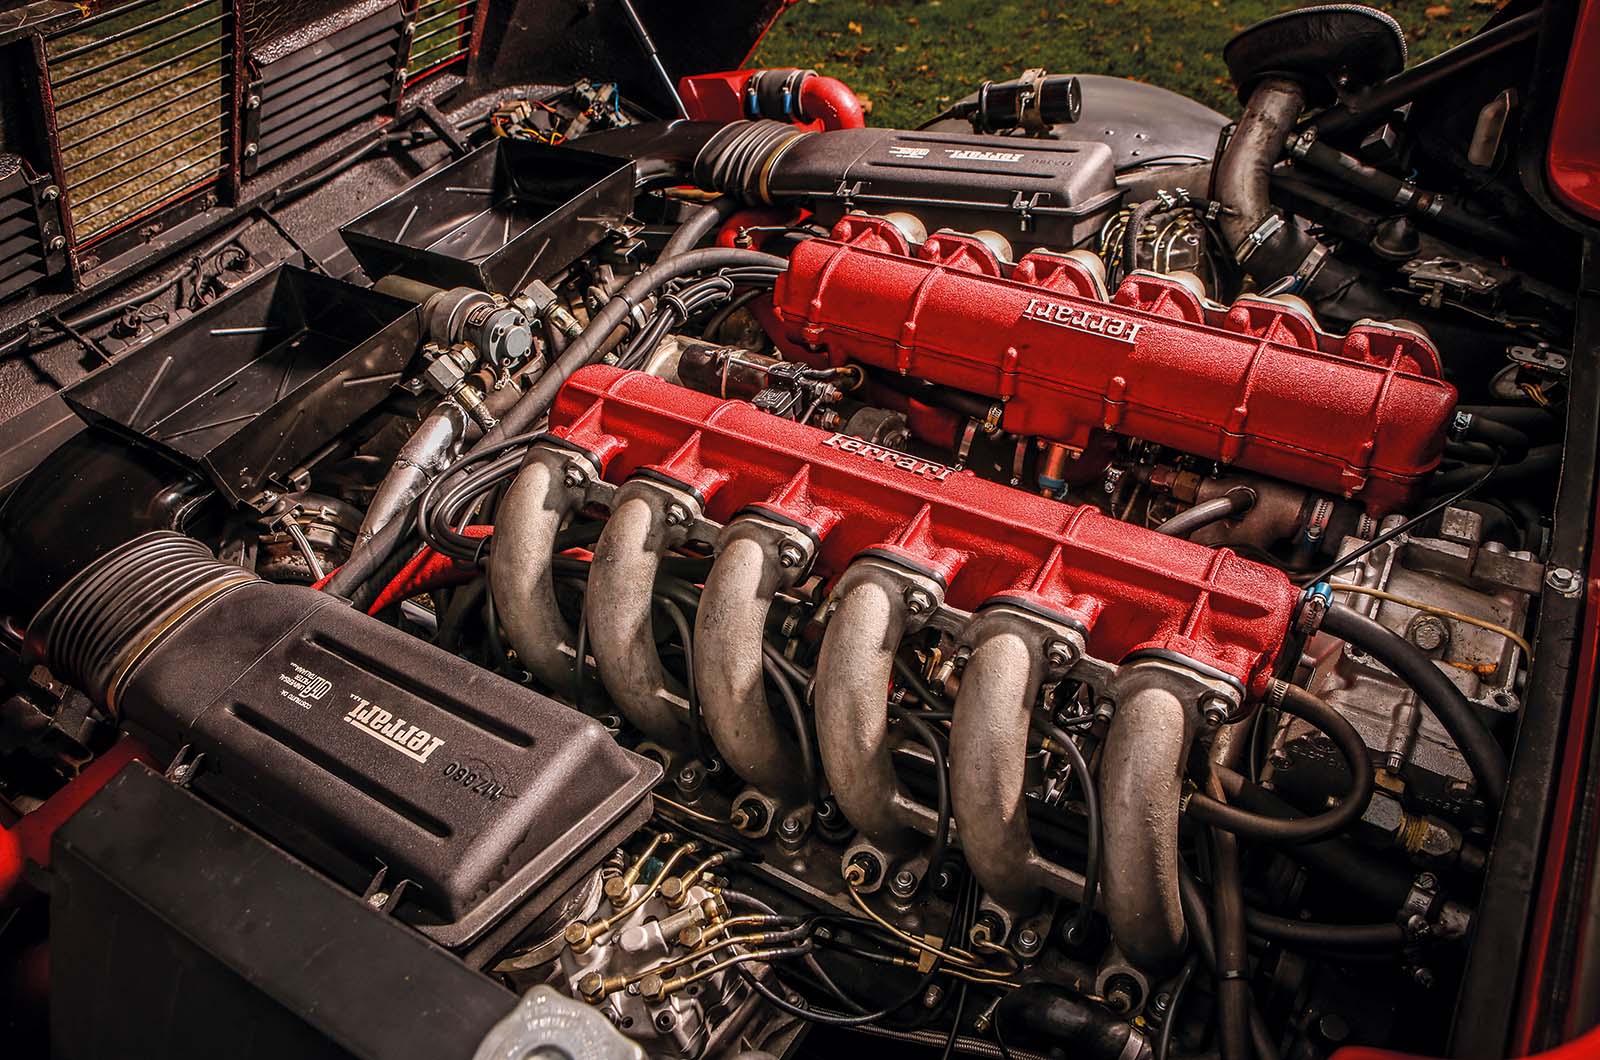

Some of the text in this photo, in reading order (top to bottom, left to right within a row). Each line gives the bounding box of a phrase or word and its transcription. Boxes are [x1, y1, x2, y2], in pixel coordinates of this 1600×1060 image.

[1023, 299, 1143, 344] Ferrari
[822, 432, 956, 480] Ferrari
[279, 673, 306, 691] UNIVERSAL
[294, 674, 312, 686] FILTER
[343, 700, 446, 764] Ferrari
